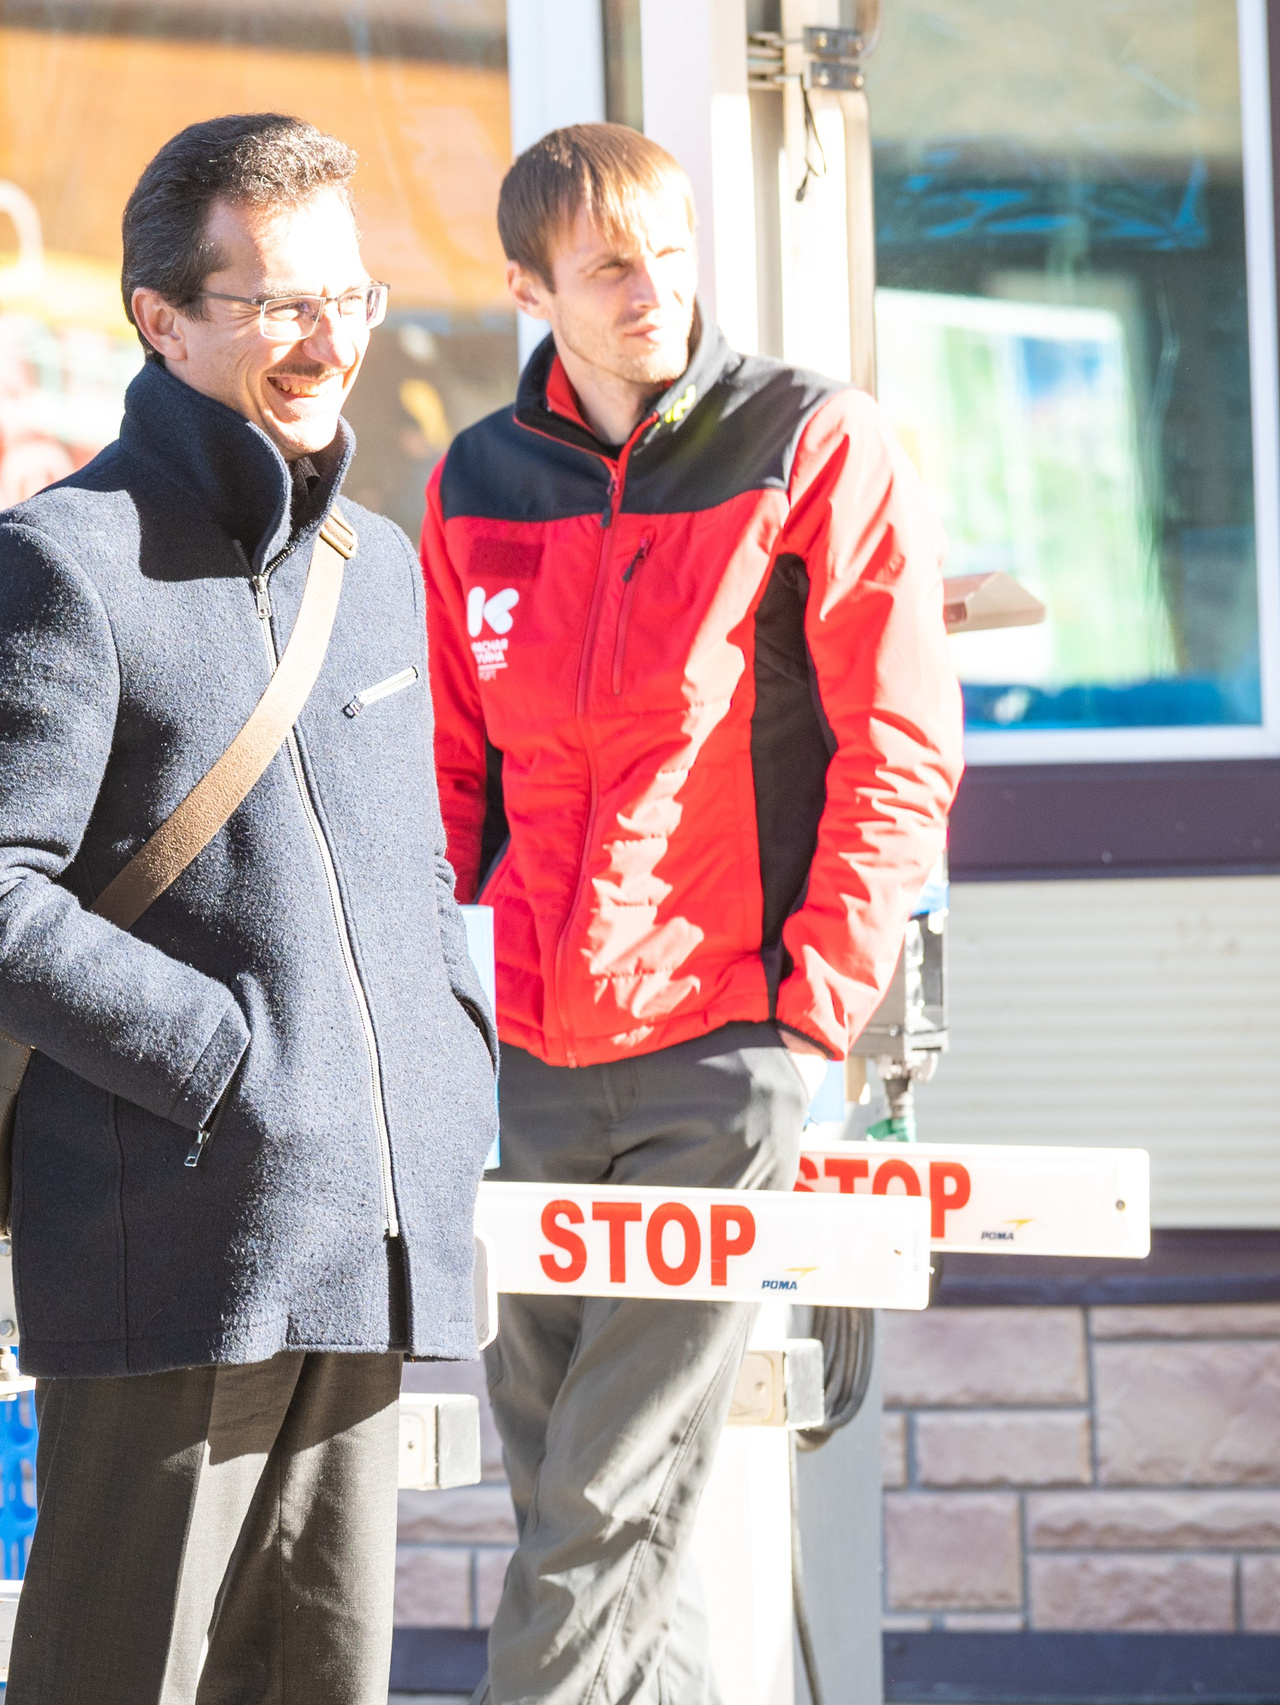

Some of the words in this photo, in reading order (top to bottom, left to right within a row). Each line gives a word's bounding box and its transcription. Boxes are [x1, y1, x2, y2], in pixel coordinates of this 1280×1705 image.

[980, 1231, 1015, 1241] POMA
[539, 1199, 756, 1286] STOP
[761, 1280, 798, 1290] POMA
